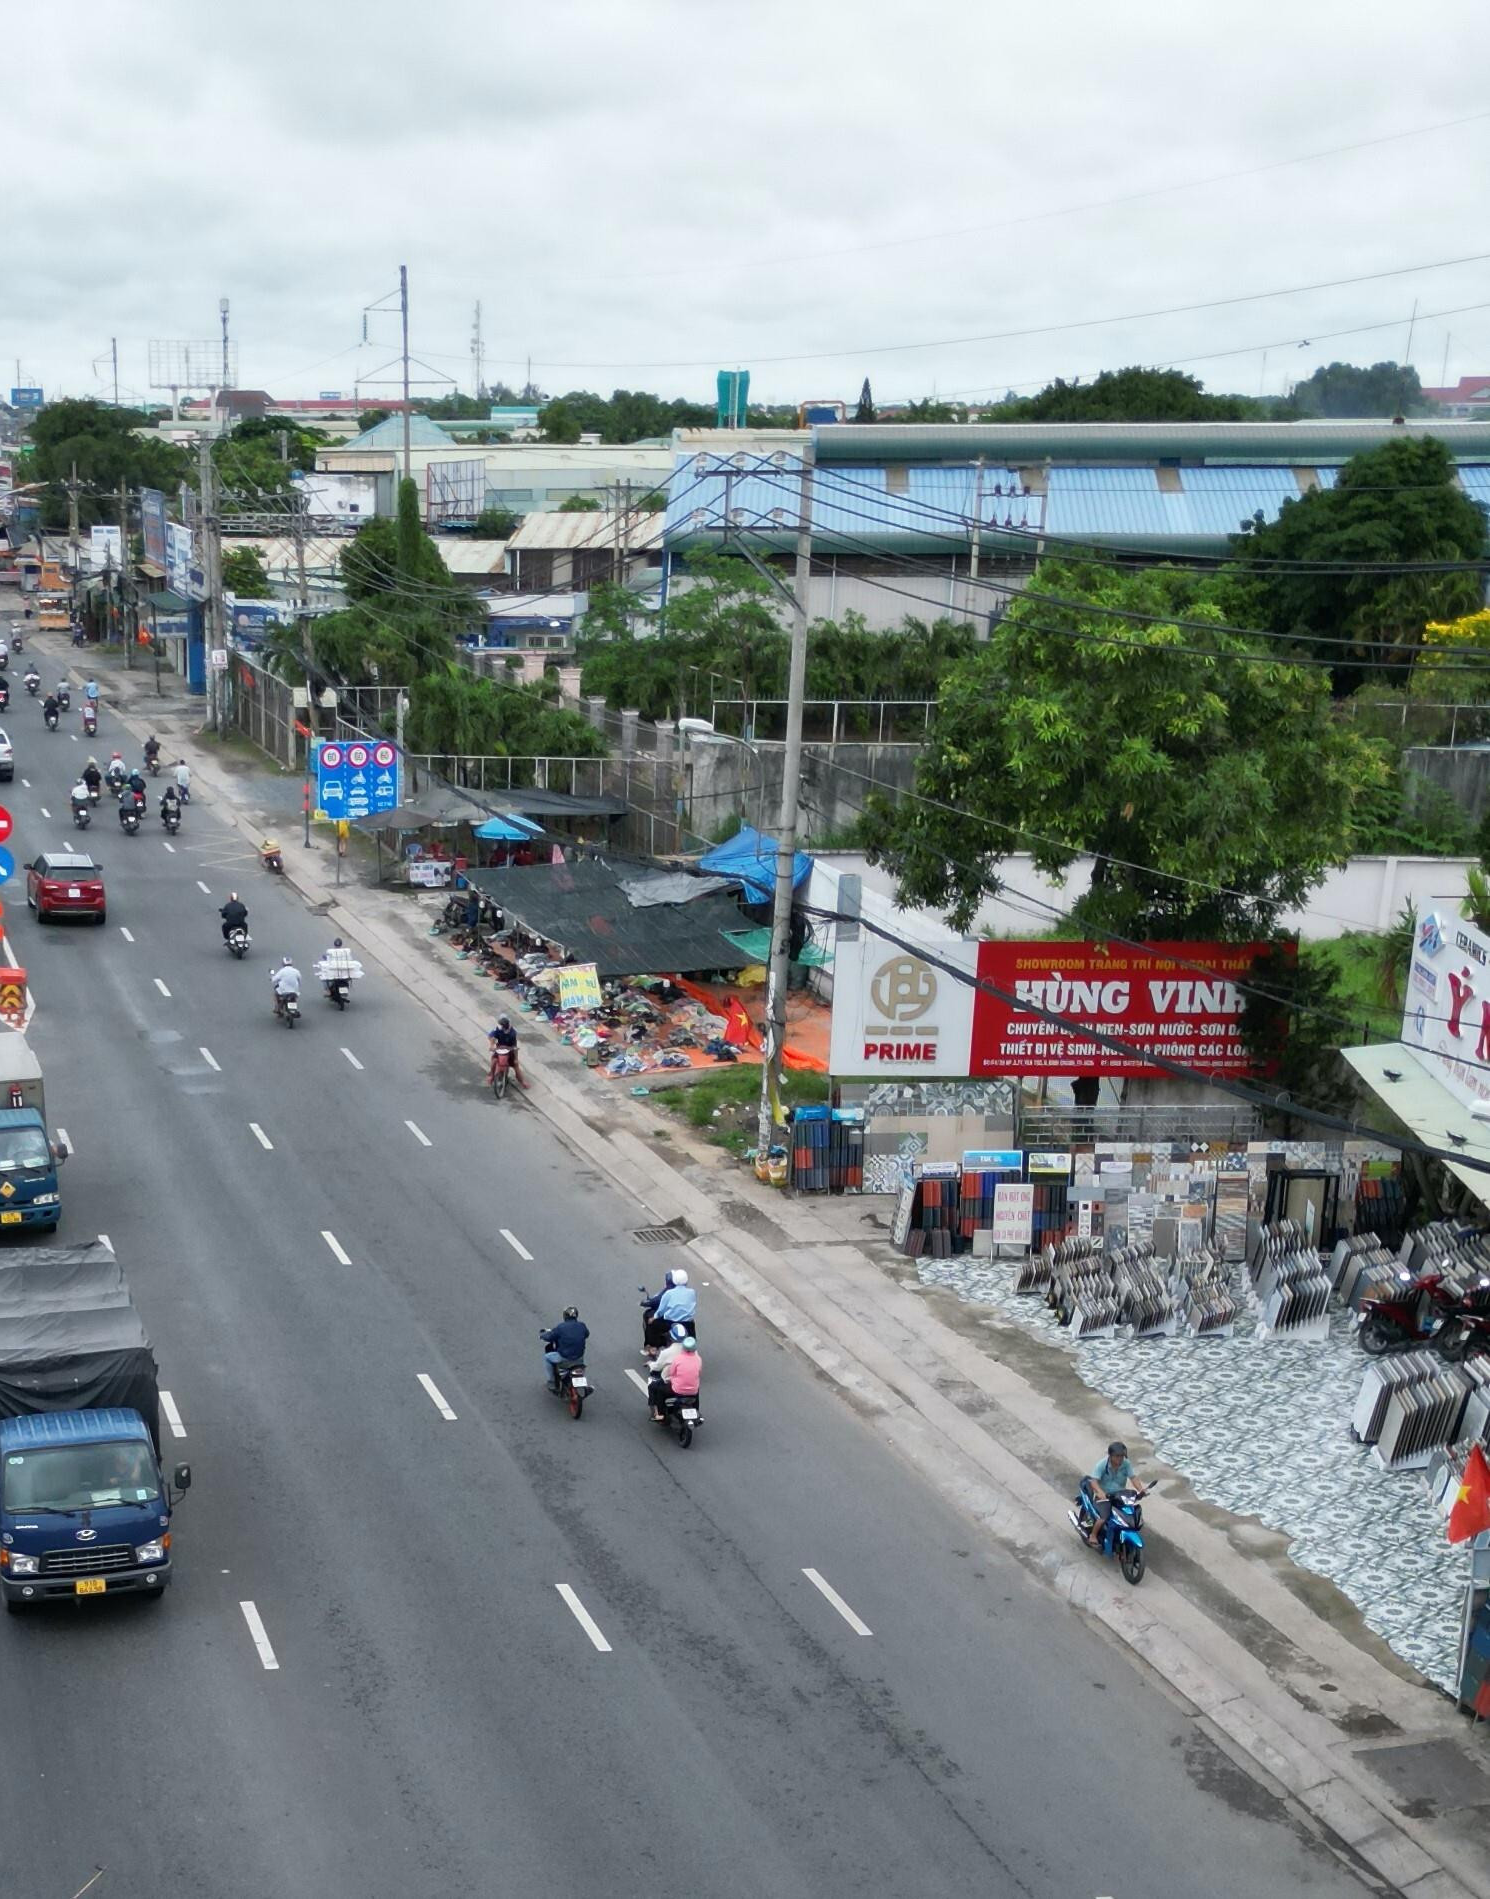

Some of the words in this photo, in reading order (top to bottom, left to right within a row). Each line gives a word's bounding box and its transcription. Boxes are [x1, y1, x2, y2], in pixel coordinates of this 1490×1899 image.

[1015, 958, 1085, 970] SHOWROOM
[1090, 959, 1128, 970] TRANG
[1132, 956, 1151, 970] TRÍ
[1013, 972, 1130, 1014] HÙNG
[864, 1043, 938, 1061] PRIME
[1000, 1039, 1033, 1056] THIẾT
[1035, 1043, 1048, 1057] BỊ
[1050, 1040, 1066, 1058] VỆ
[1154, 1042, 1196, 1057] PHÔNG
[1198, 1042, 1224, 1057] CÁC
